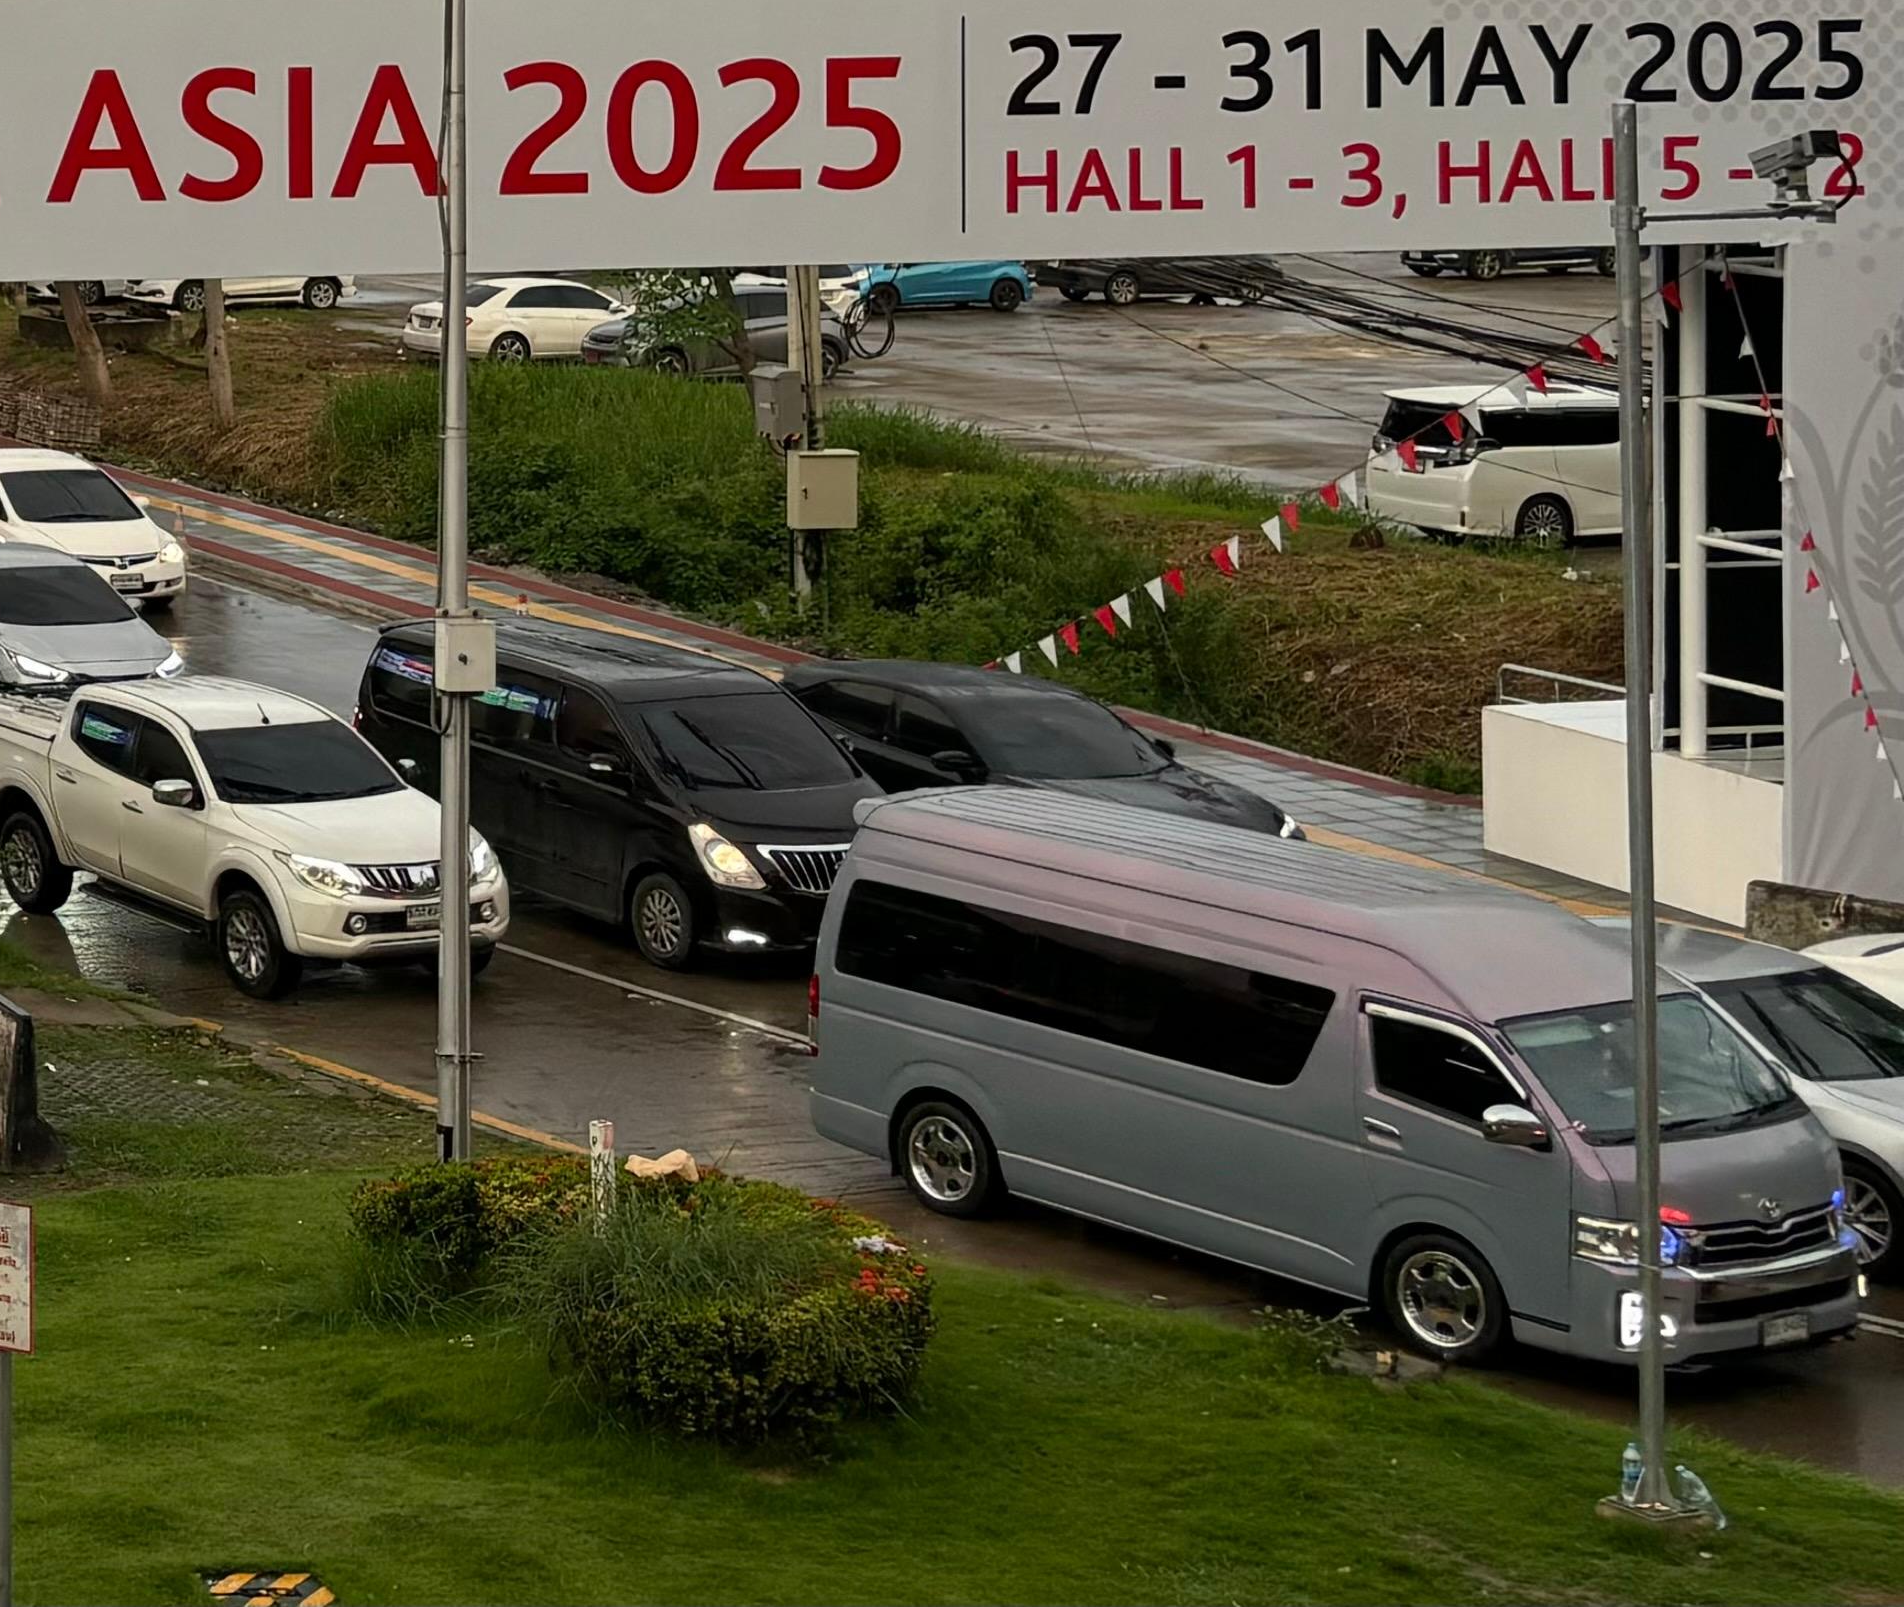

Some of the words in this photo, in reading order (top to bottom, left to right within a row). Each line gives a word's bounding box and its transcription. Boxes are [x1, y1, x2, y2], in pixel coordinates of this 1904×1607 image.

[1007, 33, 1122, 116] 27
[1219, 28, 1323, 113] 31
[1366, 23, 1593, 109] MAY
[1623, 19, 1865, 103] 2025
[46, 64, 446, 203] ASIA
[498, 56, 901, 196] 2025
[1006, 148, 1204, 214] HALL
[1226, 145, 1257, 209] 1
[1340, 142, 1407, 219] 3,
[1660, 136, 1700, 201] 5
